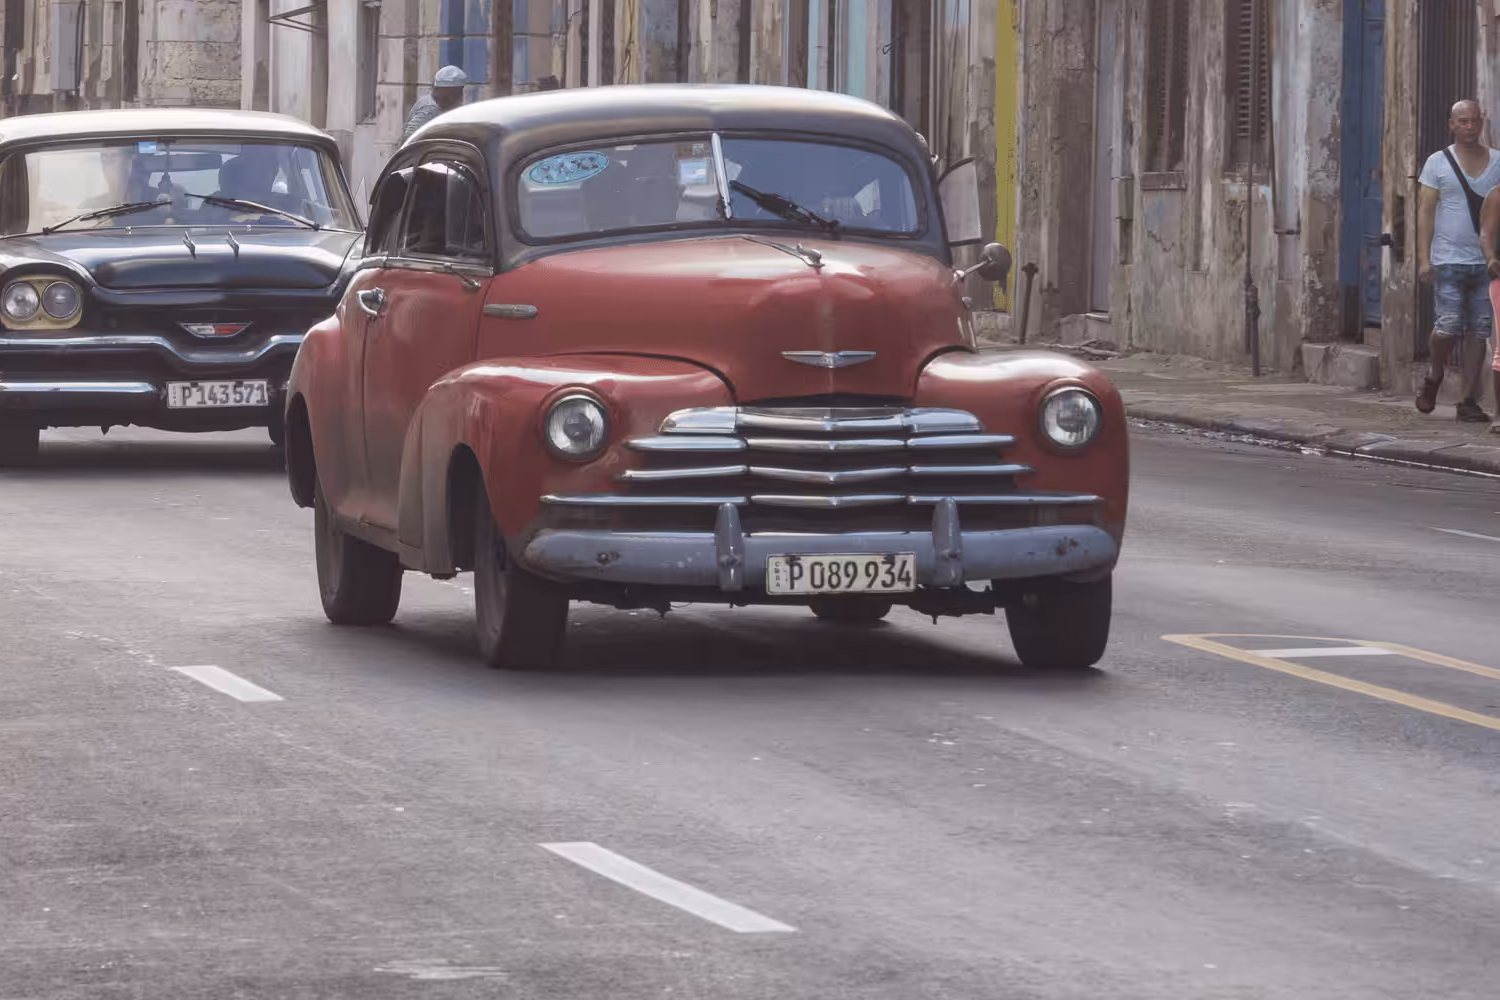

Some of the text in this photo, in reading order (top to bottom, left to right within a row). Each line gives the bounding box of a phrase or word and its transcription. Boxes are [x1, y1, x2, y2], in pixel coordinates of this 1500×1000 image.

[182, 383, 266, 406] P 143 571
[789, 560, 911, 590] P 089 934
